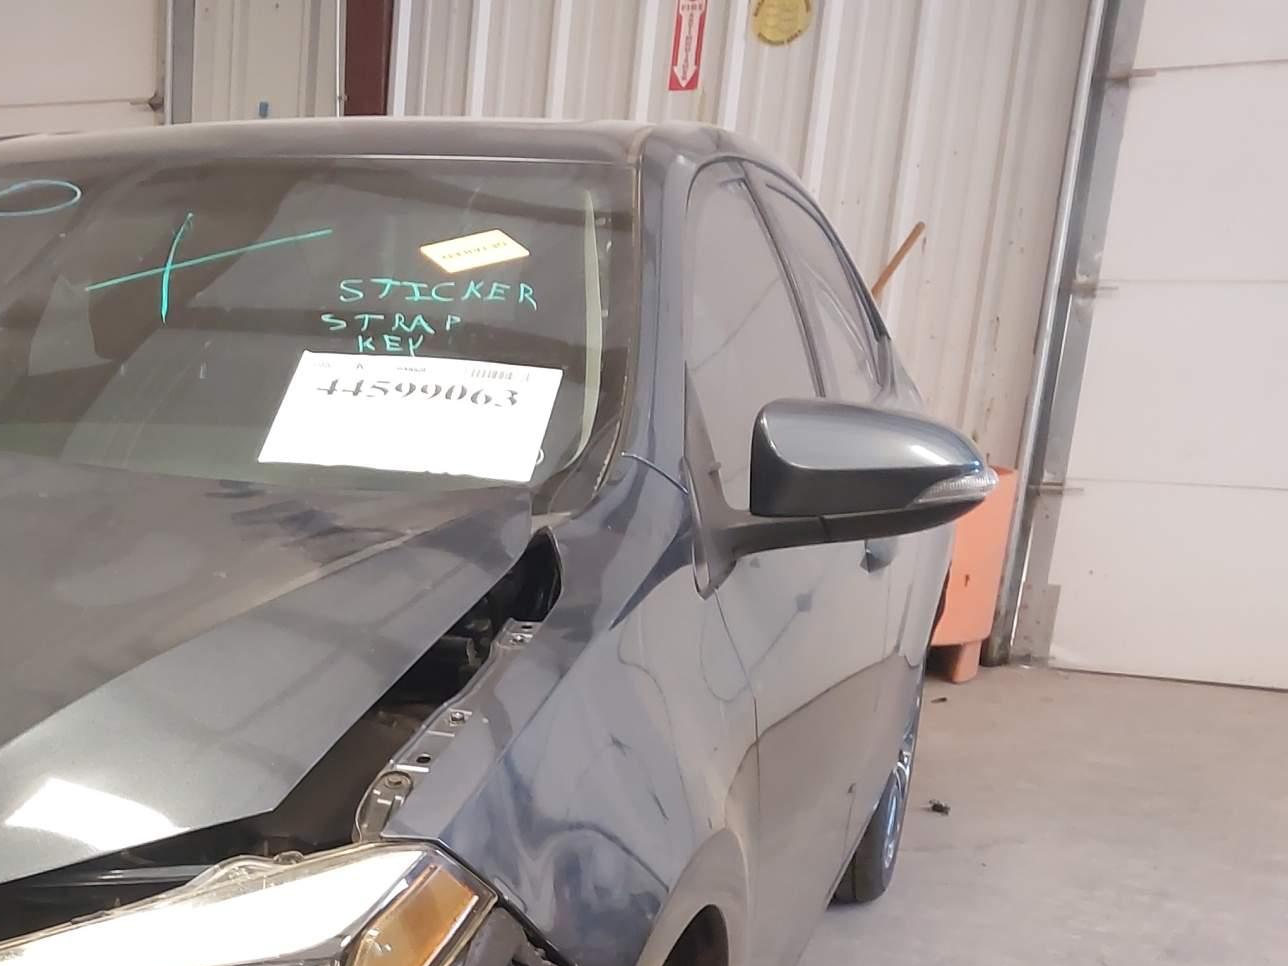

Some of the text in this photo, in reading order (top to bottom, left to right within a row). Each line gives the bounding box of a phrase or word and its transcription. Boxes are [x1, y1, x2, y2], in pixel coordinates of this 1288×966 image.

[339, 278, 537, 310] STICKER
[320, 313, 462, 335] STRAP
[357, 335, 424, 357] KEY
[317, 378, 519, 407] 44599063
